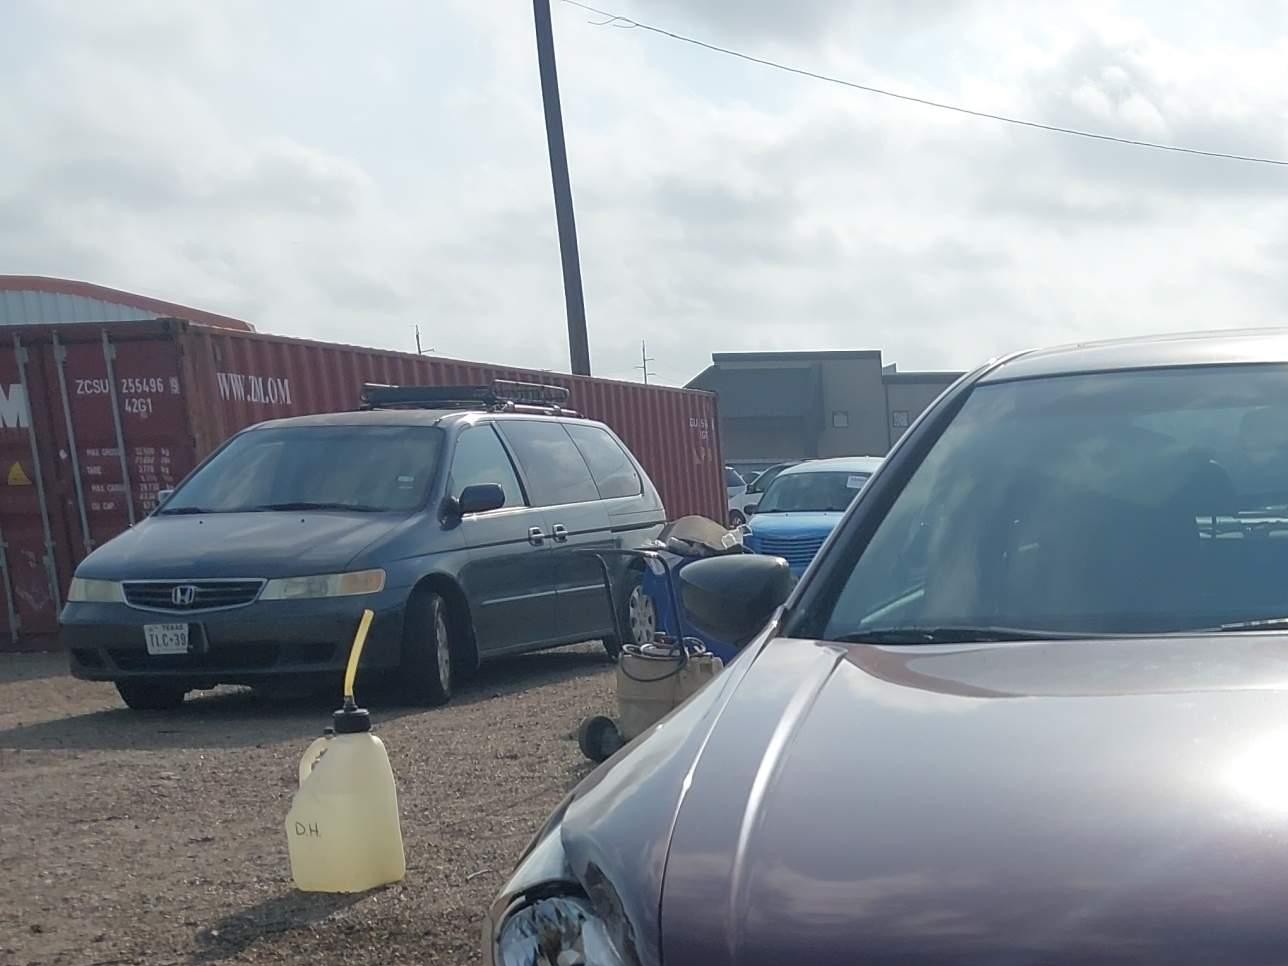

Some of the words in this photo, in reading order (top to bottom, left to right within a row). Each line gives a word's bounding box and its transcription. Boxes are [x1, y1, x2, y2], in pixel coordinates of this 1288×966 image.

[76, 379, 110, 395] ZCSU
[121, 377, 164, 394] 255496
[124, 398, 153, 413] 42G1
